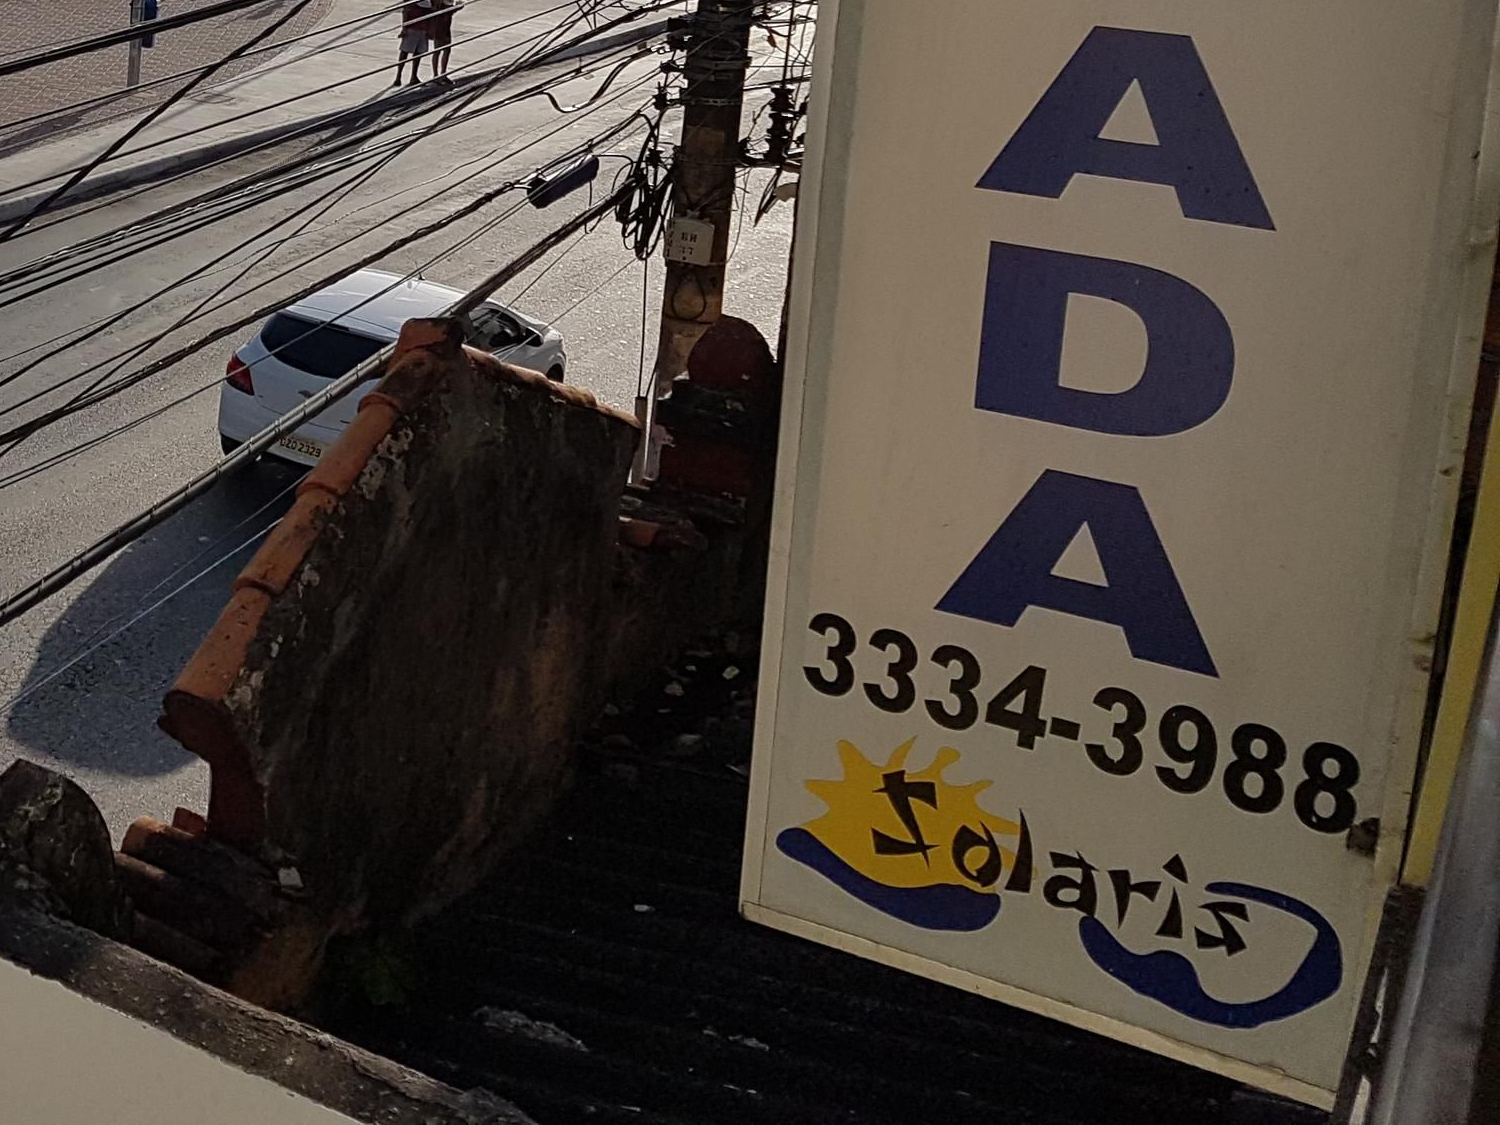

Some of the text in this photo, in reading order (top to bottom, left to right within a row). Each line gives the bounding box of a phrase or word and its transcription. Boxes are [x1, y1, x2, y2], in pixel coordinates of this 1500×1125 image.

[298, 443, 321, 457] 2329
[803, 613, 1361, 835] 3334-3988
[871, 769, 1252, 958] Solaris
